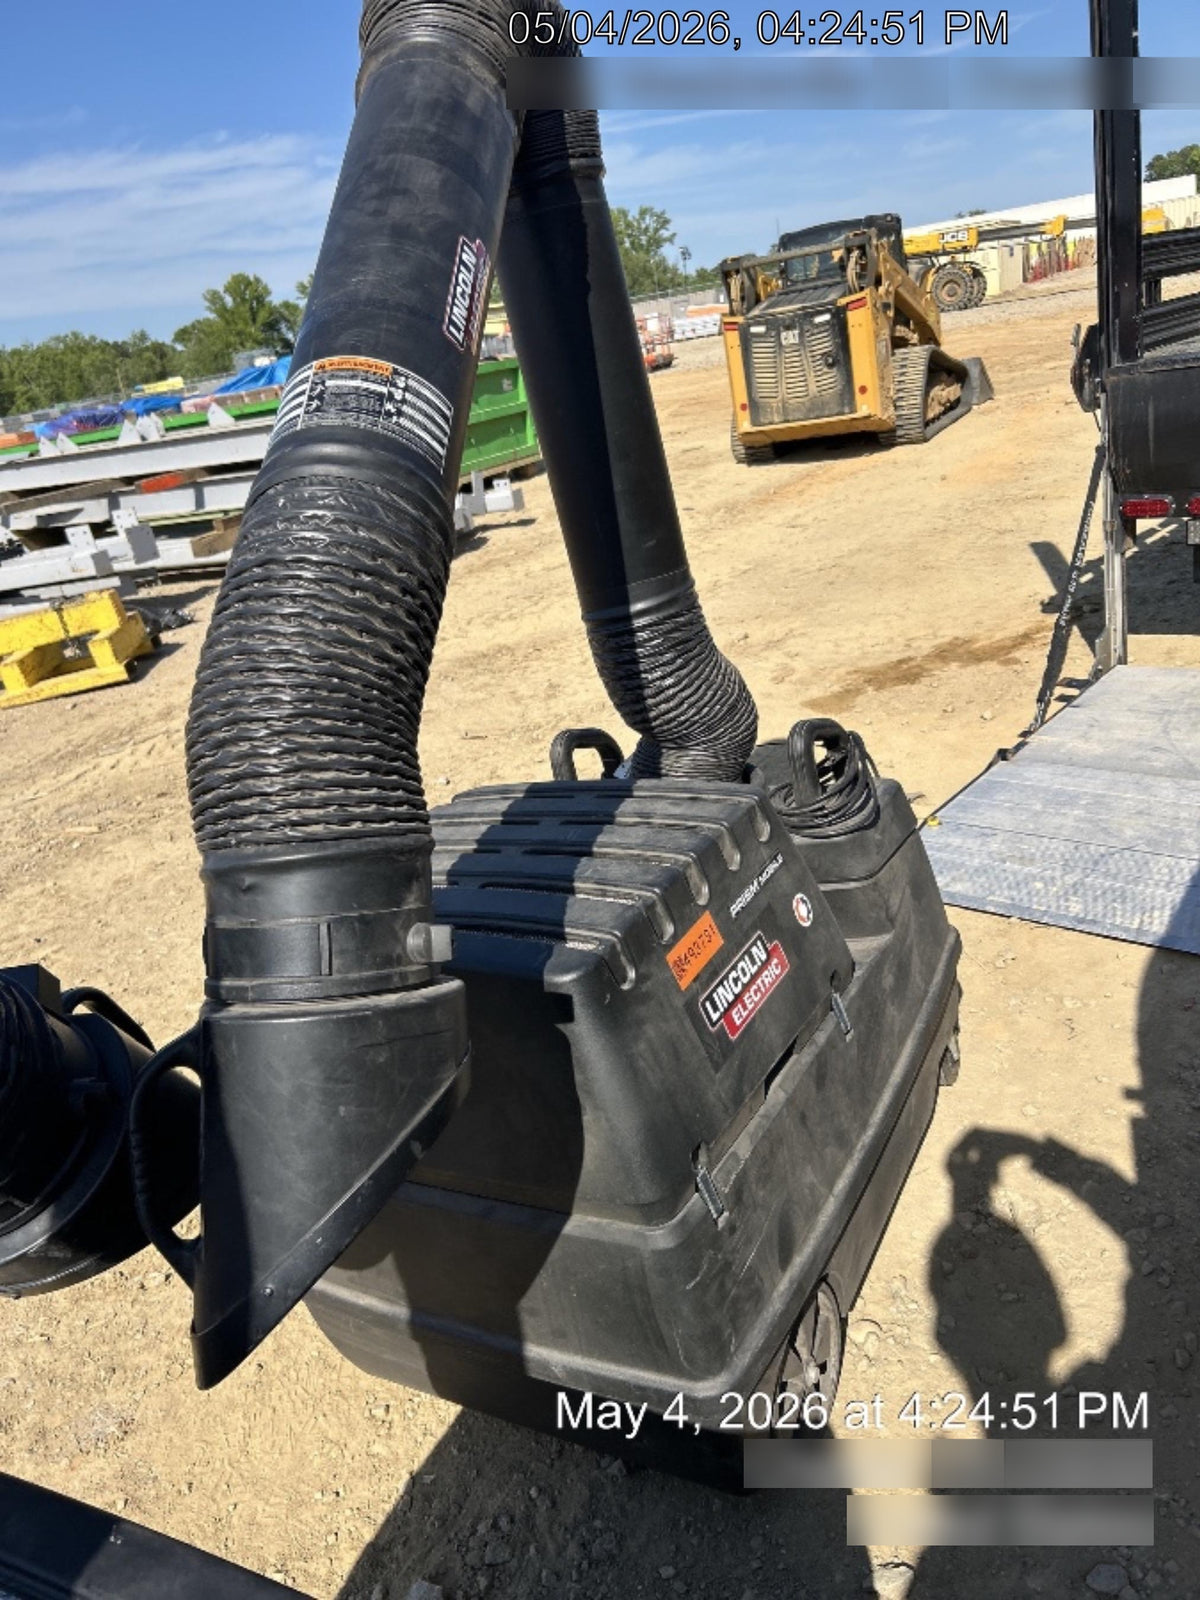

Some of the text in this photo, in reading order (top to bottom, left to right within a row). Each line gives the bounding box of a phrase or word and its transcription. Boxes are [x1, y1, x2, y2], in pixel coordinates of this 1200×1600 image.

[939, 230, 968, 243] JCB
[449, 244, 477, 343] LINCOLN
[704, 939, 769, 1023] LINCOLN
[731, 957, 782, 1026] ELECTRIC
